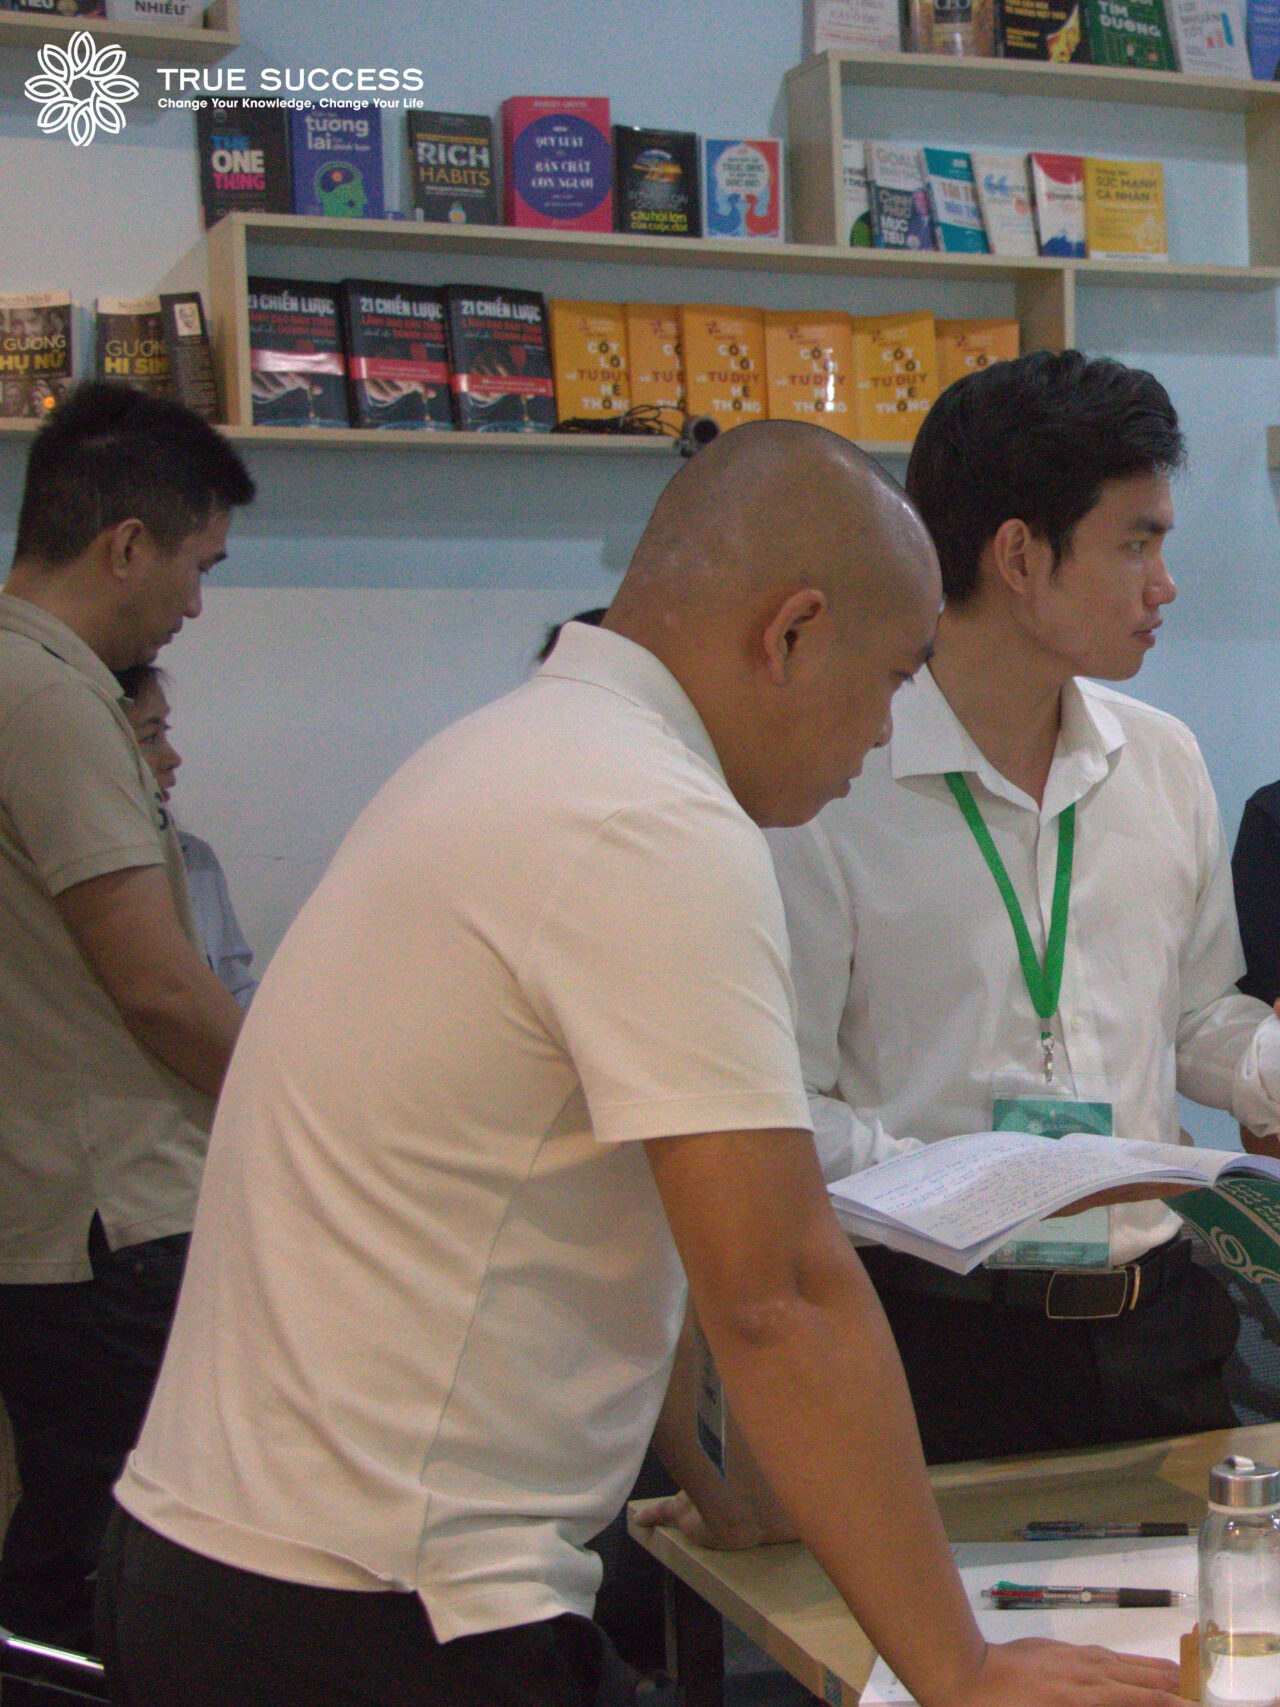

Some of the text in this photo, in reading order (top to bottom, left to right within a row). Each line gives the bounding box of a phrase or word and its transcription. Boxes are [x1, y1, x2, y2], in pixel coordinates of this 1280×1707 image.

[212, 135, 251, 149] THE
[308, 132, 331, 150] lai
[211, 150, 265, 174] ONE
[416, 141, 490, 168] RICH
[212, 173, 266, 191] THING
[418, 167, 491, 187] HABITS
[813, 374, 845, 386] DY
